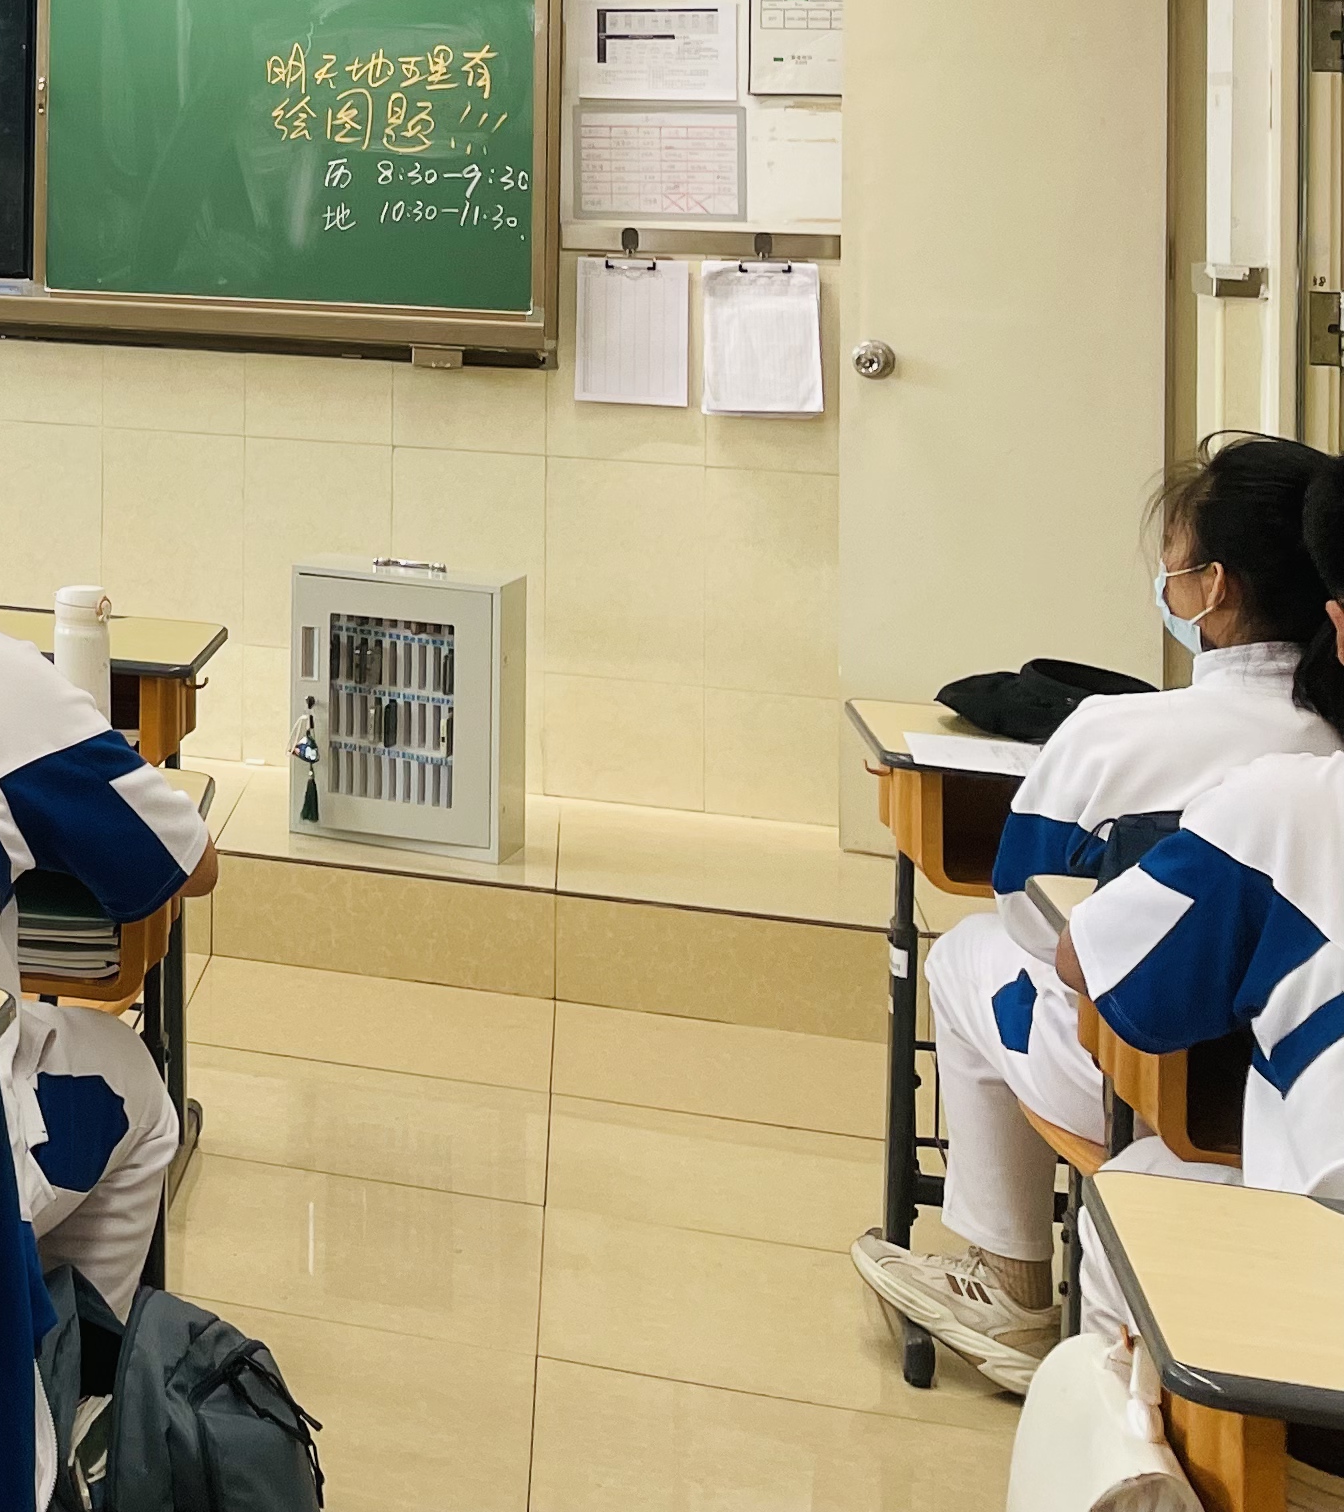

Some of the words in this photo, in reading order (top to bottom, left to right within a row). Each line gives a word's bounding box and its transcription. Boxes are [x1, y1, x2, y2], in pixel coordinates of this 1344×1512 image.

[266, 42, 499, 99] 明天地理有
[322, 202, 356, 230] 地
